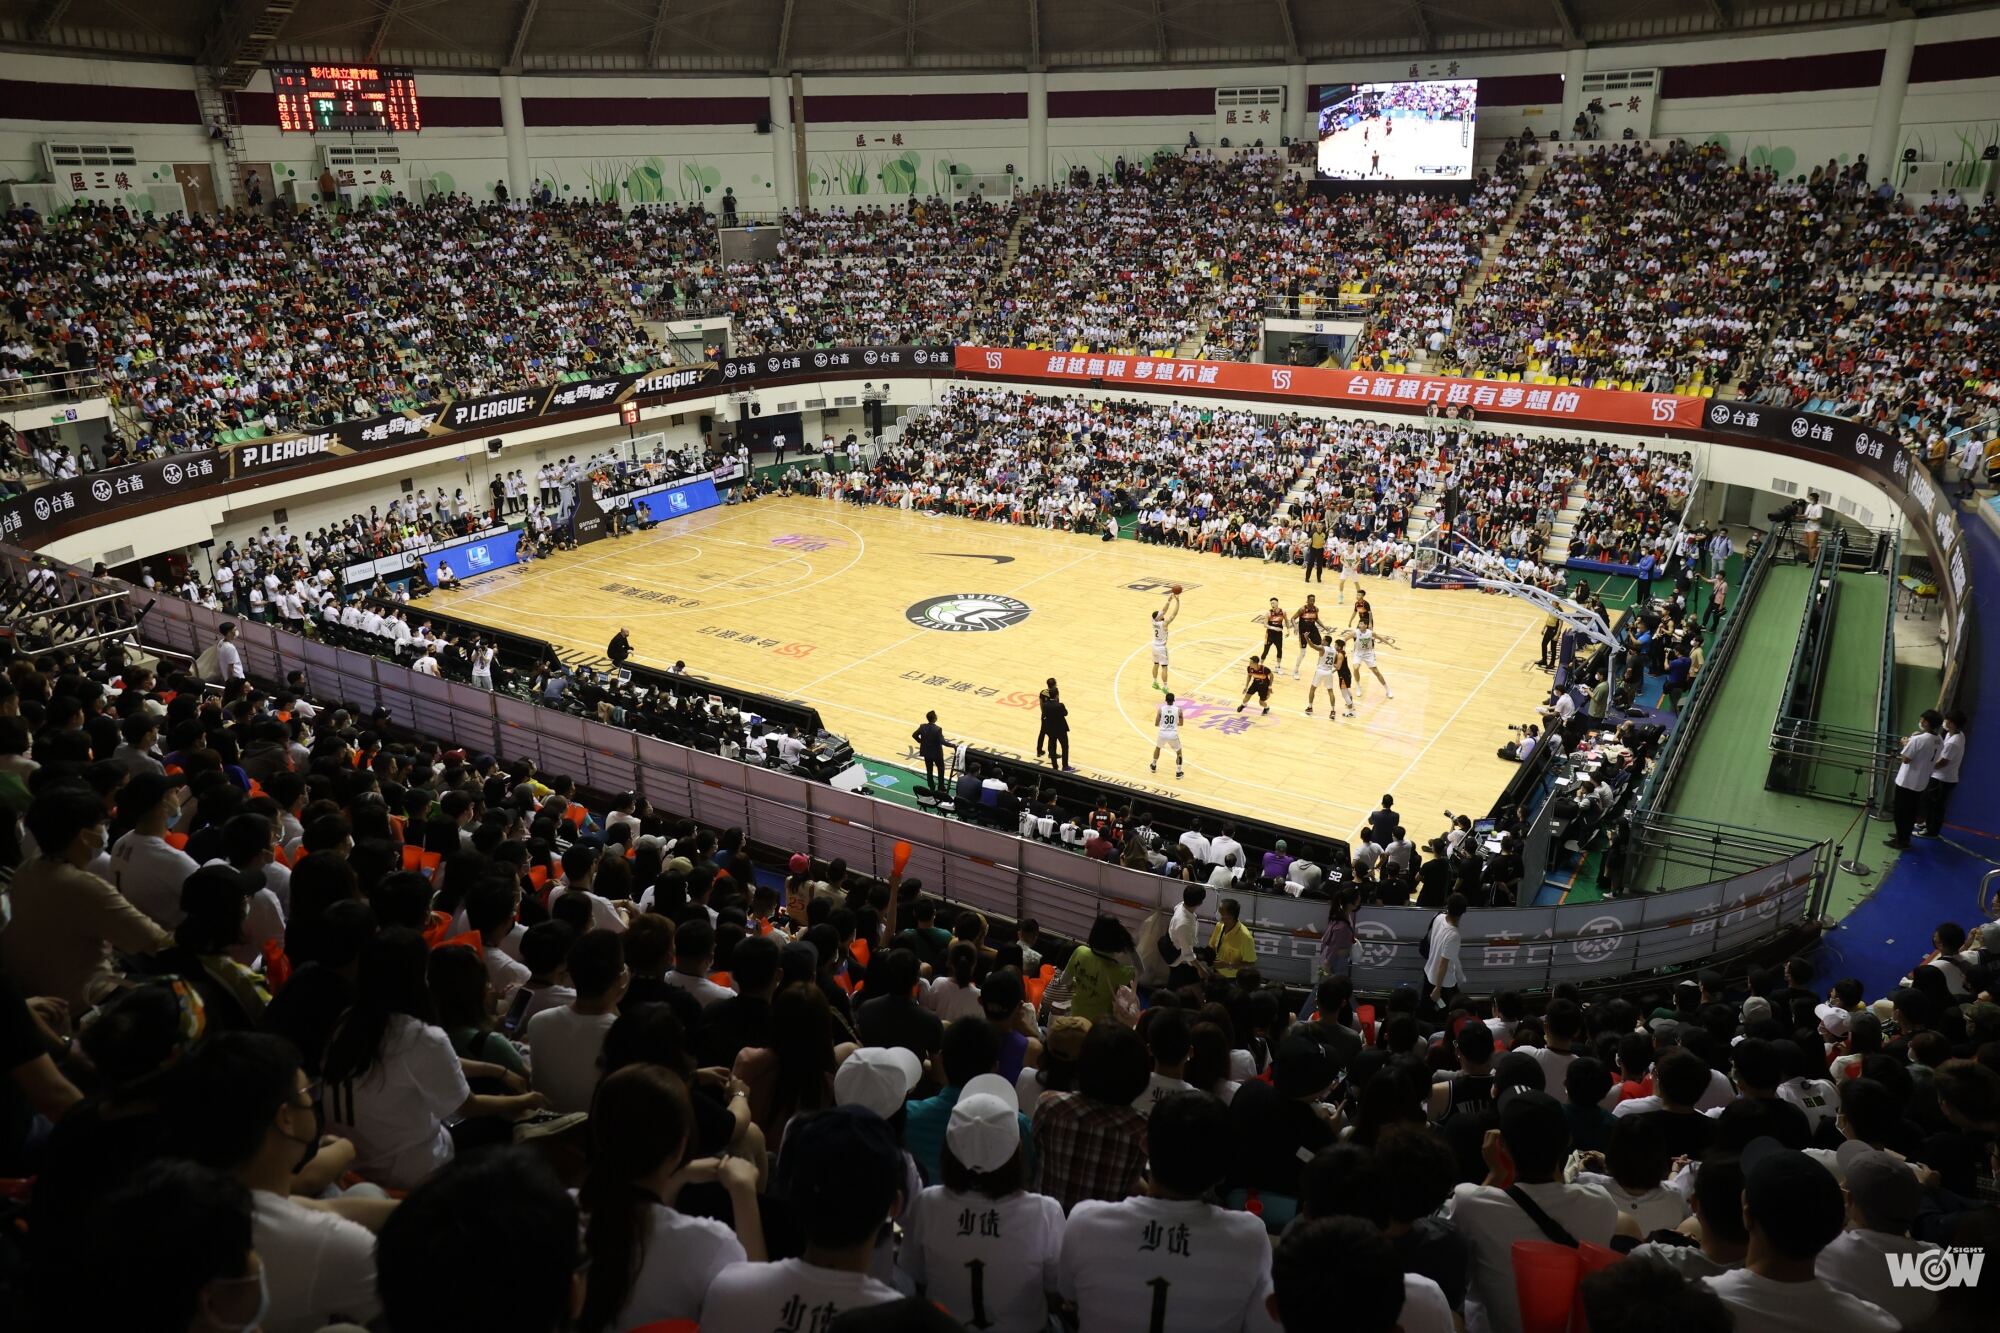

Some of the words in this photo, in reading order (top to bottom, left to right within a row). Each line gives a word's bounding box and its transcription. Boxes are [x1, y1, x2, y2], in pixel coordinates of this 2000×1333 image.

[1047, 356, 1125, 378] 超越無限
[1133, 362, 1219, 384] 夢想不滅
[1347, 376, 1581, 413] 台新銀行挺有夢想的
[456, 396, 537, 424] P.LEAGUE+
[627, 412, 637, 423] 13
[243, 432, 341, 468] P.LEAGUE+
[1164, 715, 1175, 725] 30
[1328, 870, 1343, 882] 52
